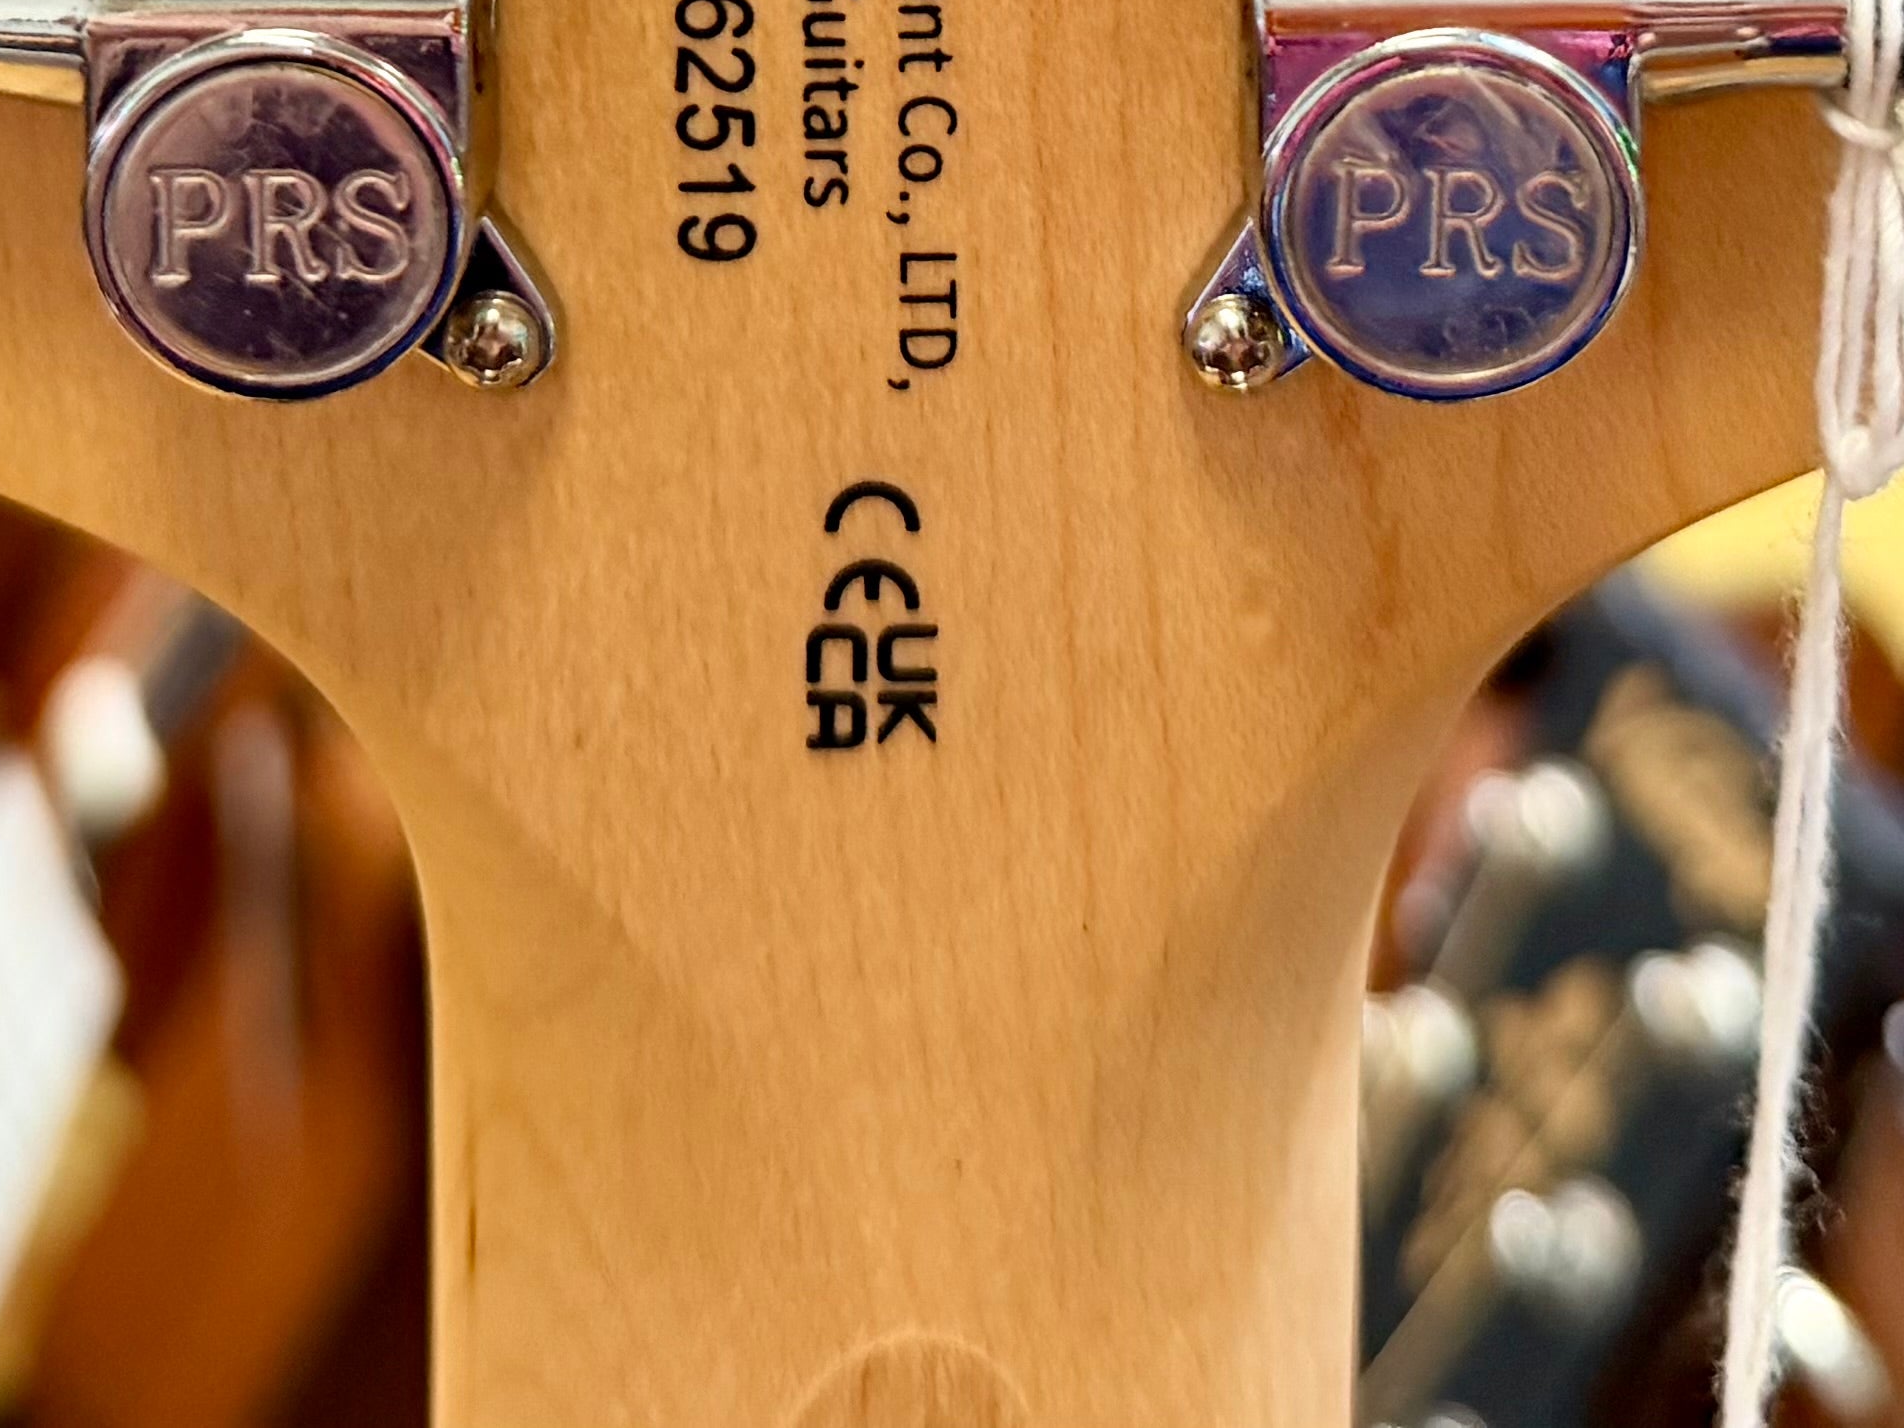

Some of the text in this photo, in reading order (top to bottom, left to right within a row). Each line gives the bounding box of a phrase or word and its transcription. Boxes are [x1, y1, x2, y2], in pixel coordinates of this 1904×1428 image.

[884, 94, 959, 227] Co.,
[1322, 156, 1592, 282] PRS
[148, 164, 414, 288] PRS
[886, 251, 959, 392] LTD,
